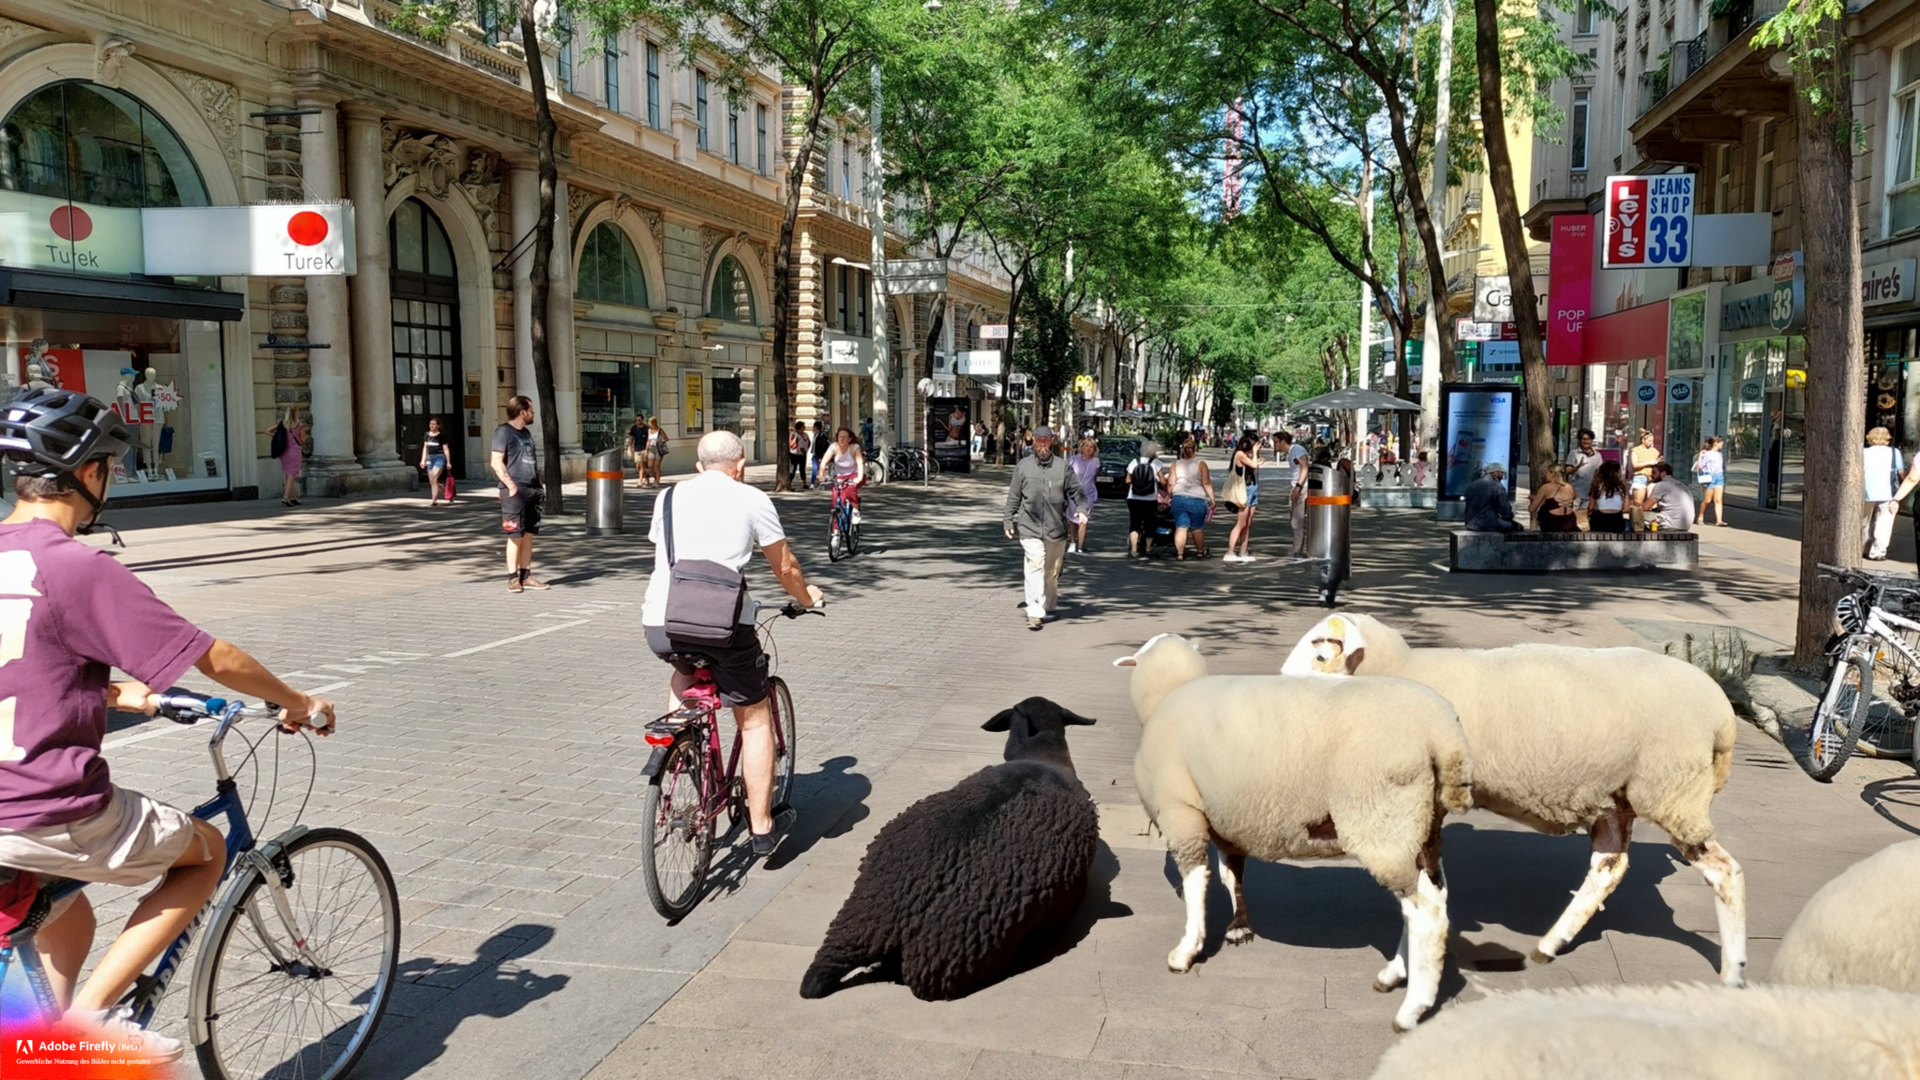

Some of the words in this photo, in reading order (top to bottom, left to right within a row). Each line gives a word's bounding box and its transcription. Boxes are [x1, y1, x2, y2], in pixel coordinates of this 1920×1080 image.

[1651, 177, 1691, 195] JEANS
[1650, 196, 1690, 214] SHOP
[1560, 224, 1587, 232] HUBER
[1648, 215, 1688, 264] 33
[45, 244, 100, 268] Turek
[283, 252, 334, 270] Turek
[1862, 266, 1901, 302] aire's
[1772, 287, 1792, 321] 33
[1557, 309, 1586, 320] POP
[109, 402, 155, 424] ALE
